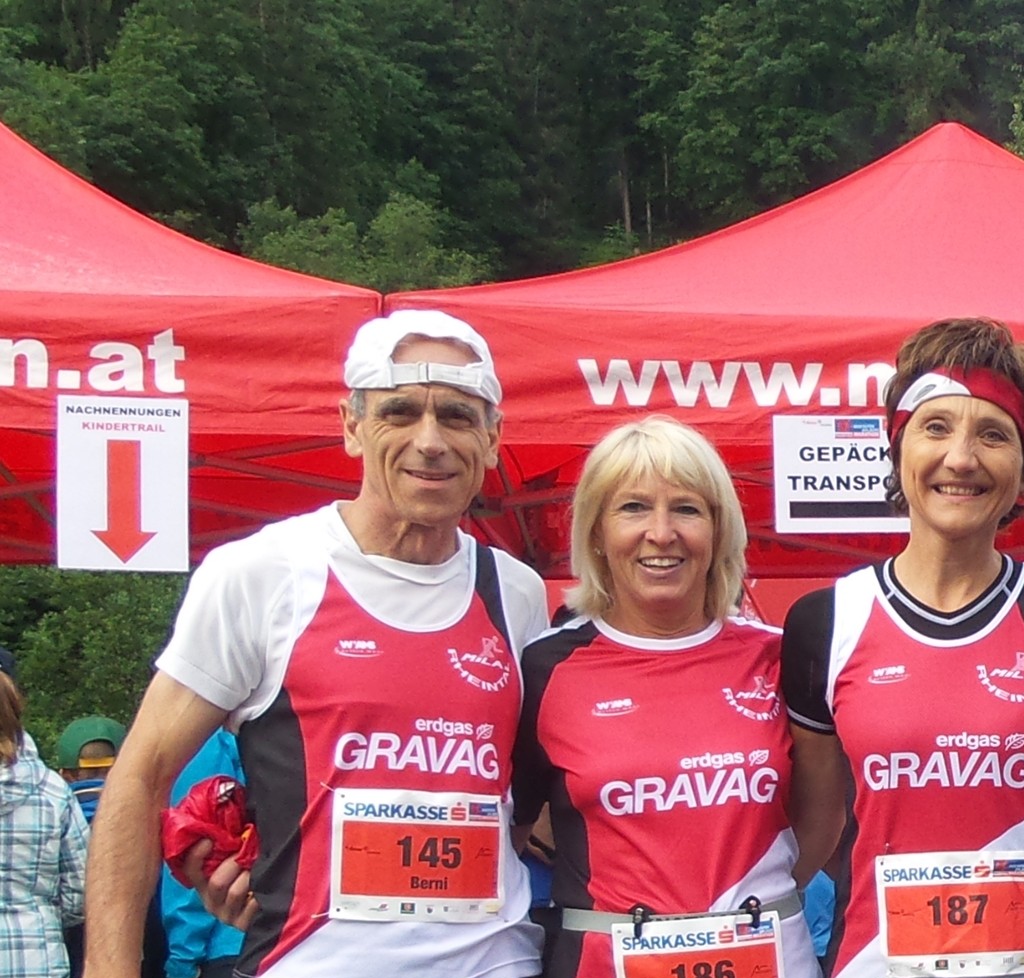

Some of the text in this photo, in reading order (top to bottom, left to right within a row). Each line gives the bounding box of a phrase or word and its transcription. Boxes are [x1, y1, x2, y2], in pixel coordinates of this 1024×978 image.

[66, 405, 181, 417] NACHNENNUNGEN
[82, 422, 165, 433] KINDERTRAIL
[415, 717, 473, 736] erdgas
[936, 732, 1001, 750] erdgas
[334, 732, 499, 780] GRAVAG
[680, 752, 744, 769] erdgas
[600, 767, 779, 816] GRAVAG
[344, 802, 448, 821] SPARKASSE
[397, 835, 462, 869] 145
[410, 876, 448, 890] Berni
[883, 866, 972, 883] SPARKASSE
[927, 894, 989, 926] 187
[622, 931, 716, 951] SPARKASSE
